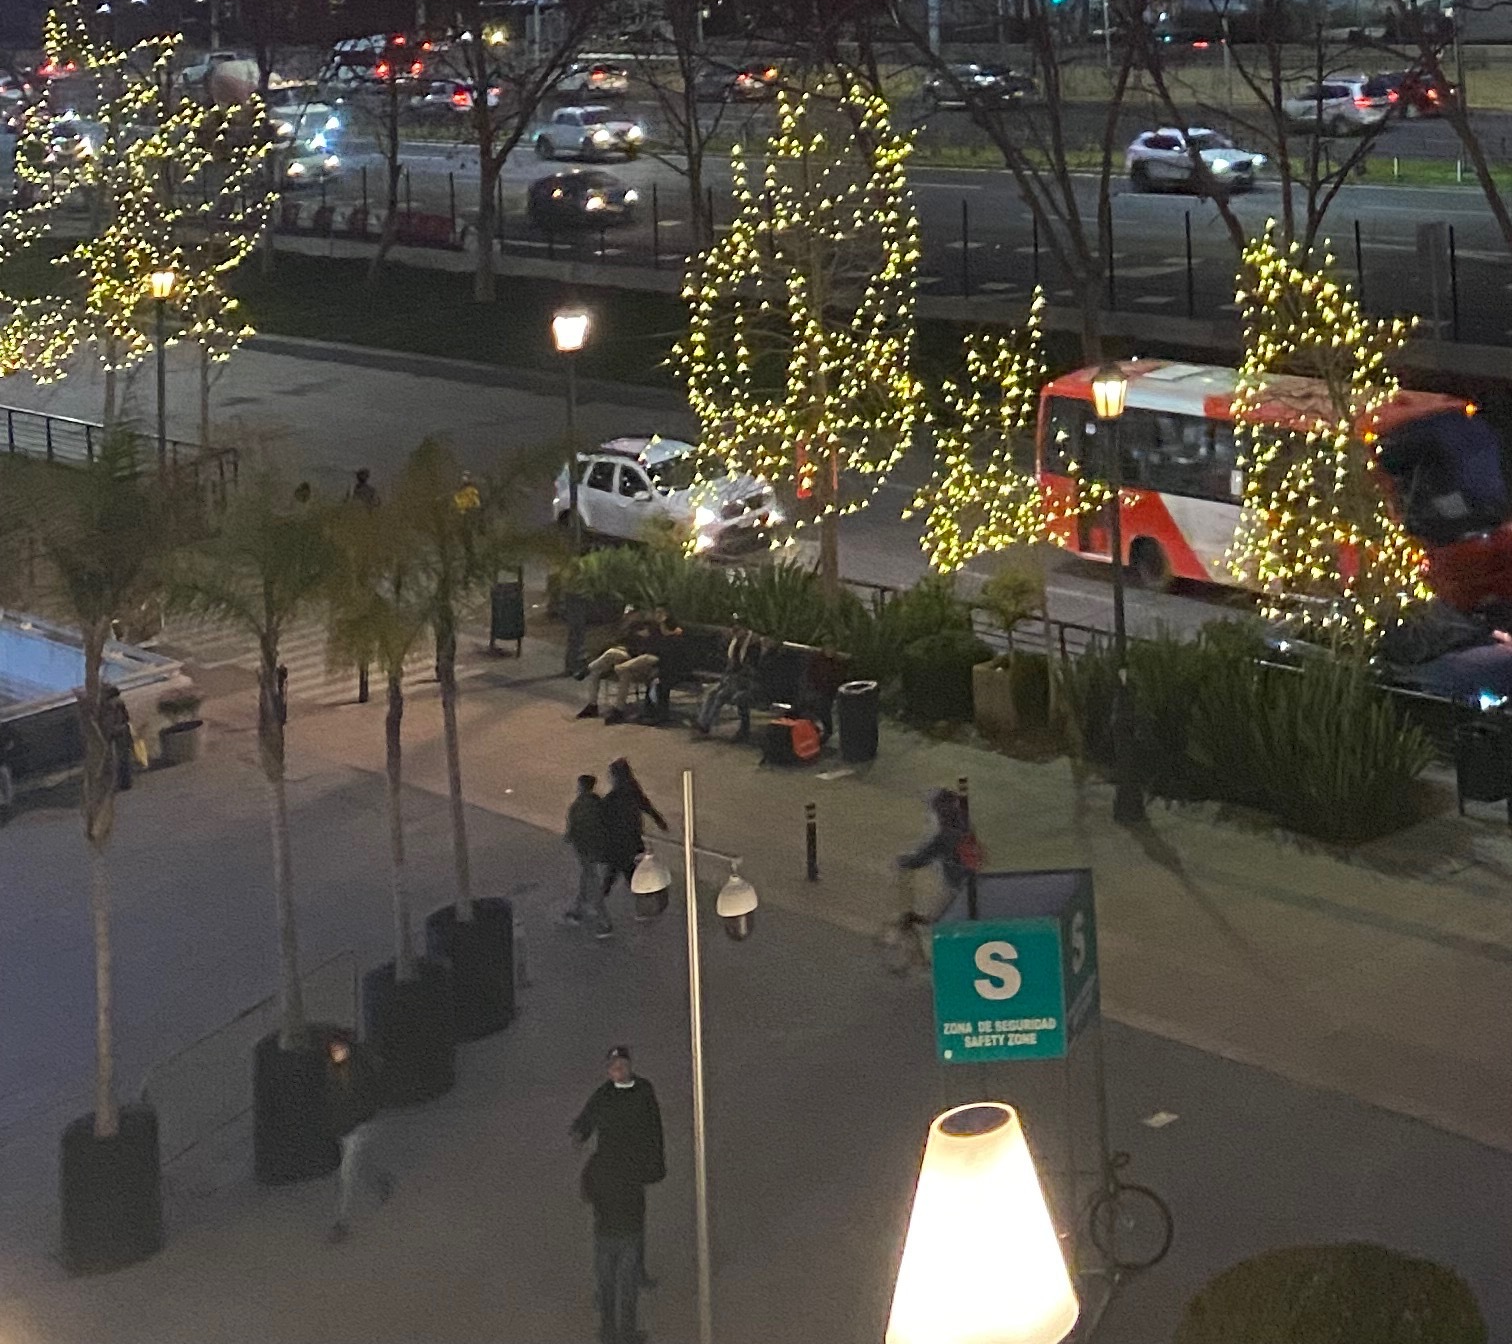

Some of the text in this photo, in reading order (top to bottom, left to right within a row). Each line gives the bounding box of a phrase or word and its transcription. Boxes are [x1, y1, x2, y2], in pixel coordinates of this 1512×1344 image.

[973, 940, 1022, 1001] S
[943, 1017, 1057, 1035] ZONA DE SEGURIDAD
[964, 1032, 1038, 1049] SAFETY ZONE
